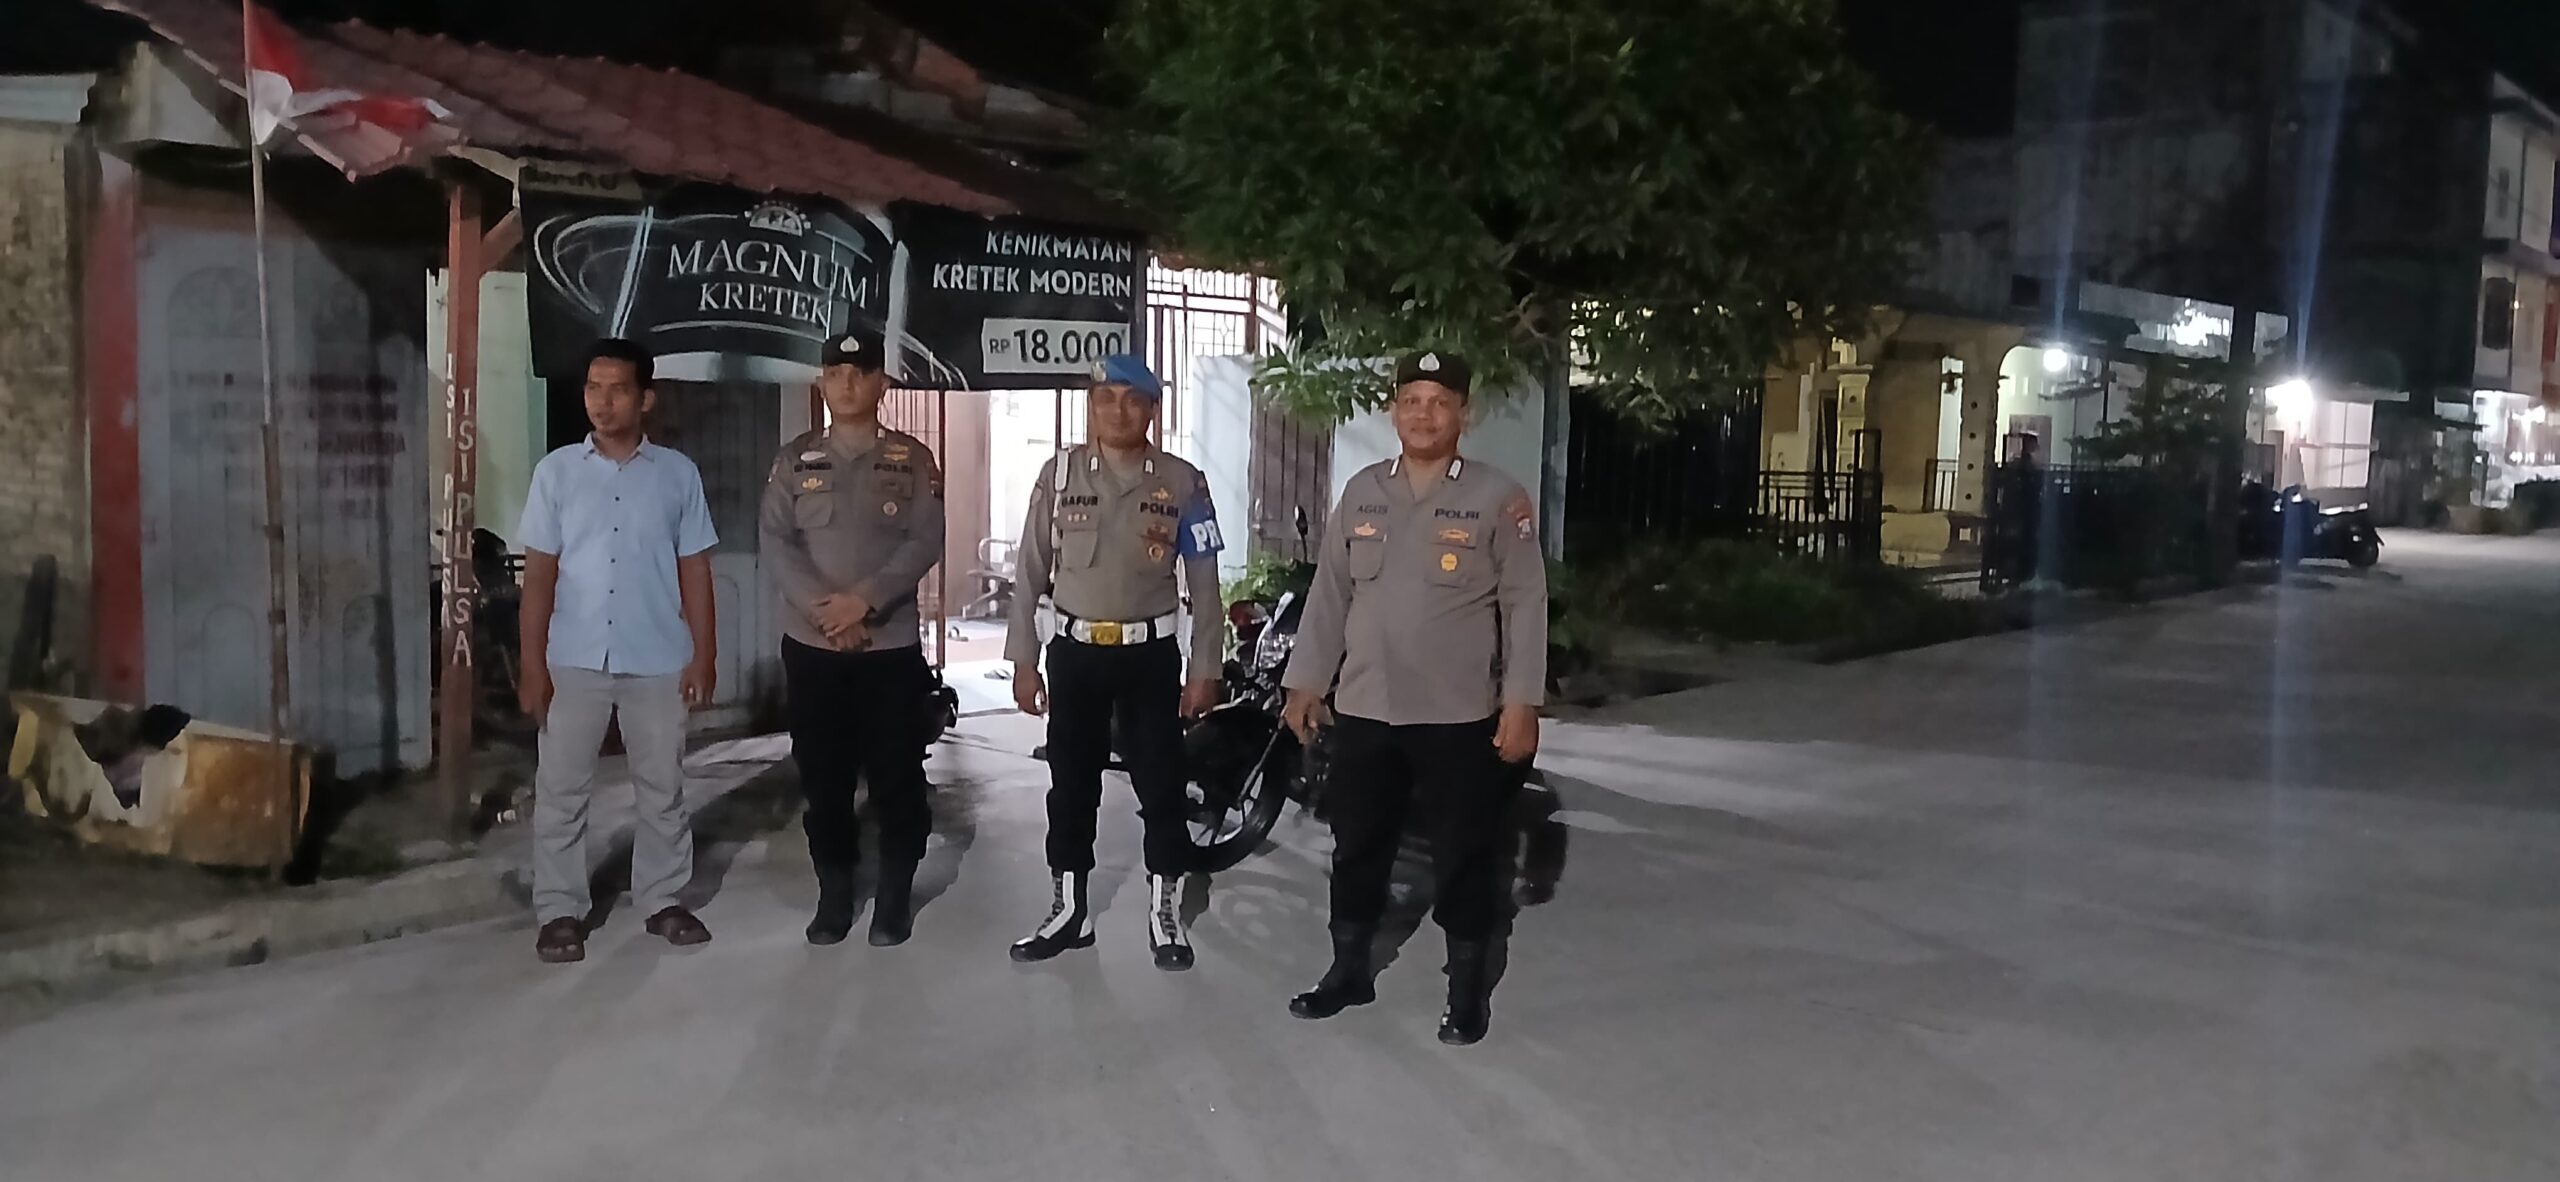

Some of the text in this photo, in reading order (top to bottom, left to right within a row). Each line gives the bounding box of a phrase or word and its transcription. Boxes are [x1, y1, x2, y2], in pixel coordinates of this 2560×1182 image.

[986, 230, 1132, 263] KENIKMATAN
[667, 239, 867, 309] MAGNUM
[933, 263, 1131, 298] KRETEK MODERN
[698, 282, 829, 328] KRETEK
[989, 328, 1122, 364] RP 18.000
[441, 353, 456, 628] ISI PULSA
[1139, 501, 1179, 518] POLRI
[1356, 504, 1389, 515] AGUS
[1434, 507, 1479, 519] POLRI
[452, 388, 474, 667] ISI PULSA
